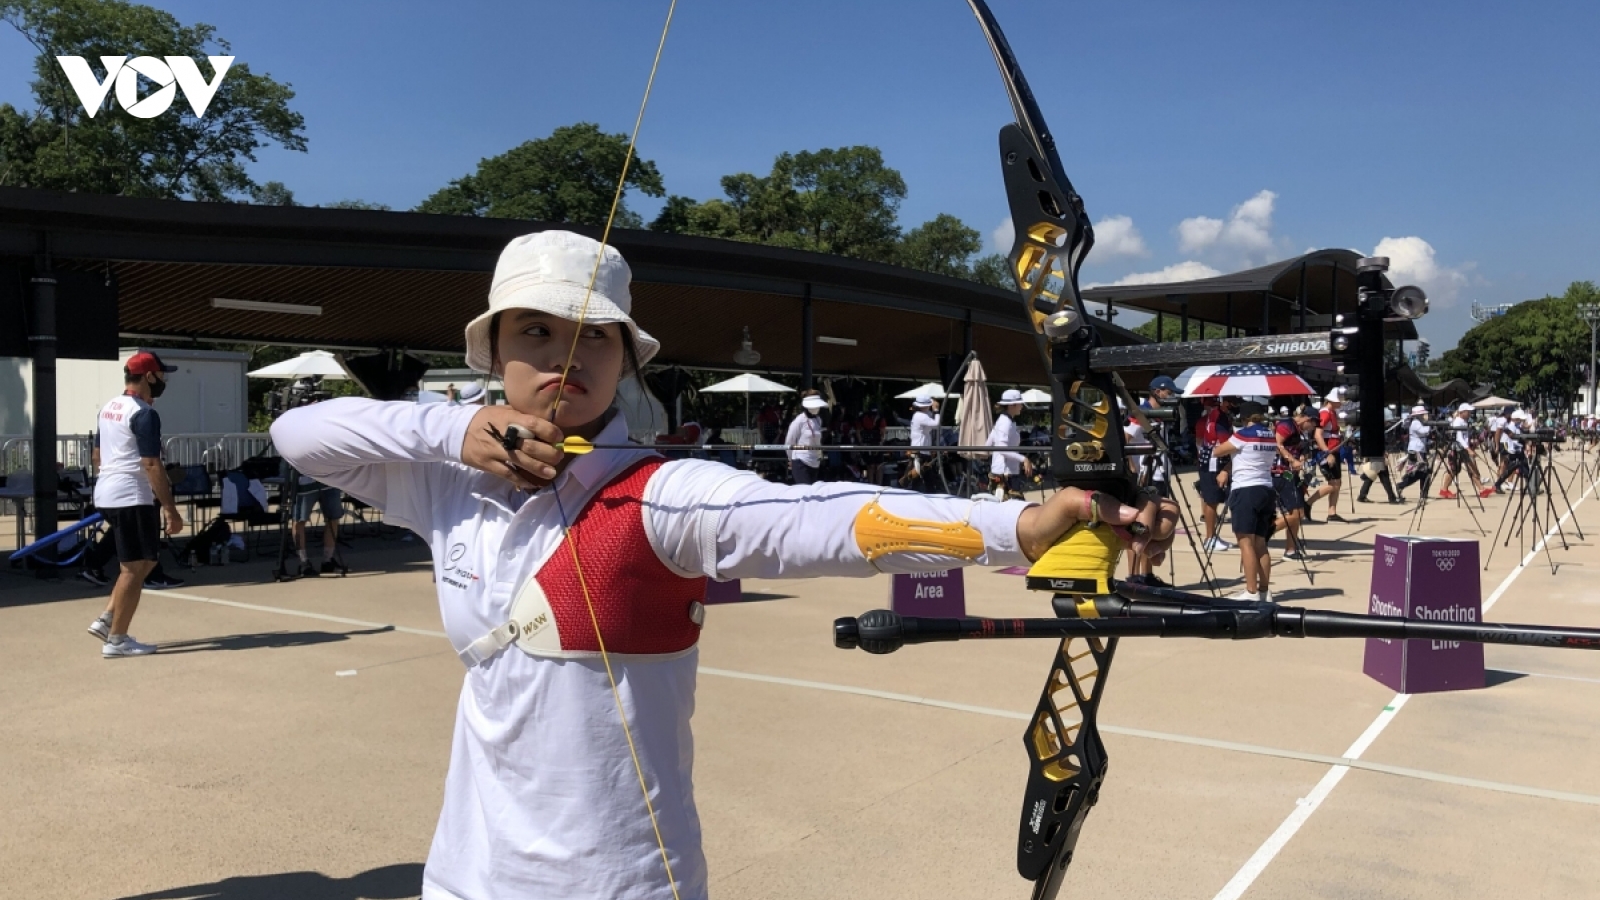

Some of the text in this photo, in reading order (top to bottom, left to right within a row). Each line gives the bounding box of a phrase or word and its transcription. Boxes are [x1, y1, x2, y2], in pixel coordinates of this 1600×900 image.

[1264, 340, 1328, 354] SHIBUYA
[914, 582, 944, 599] Area
[1415, 603, 1476, 622] Shooting
